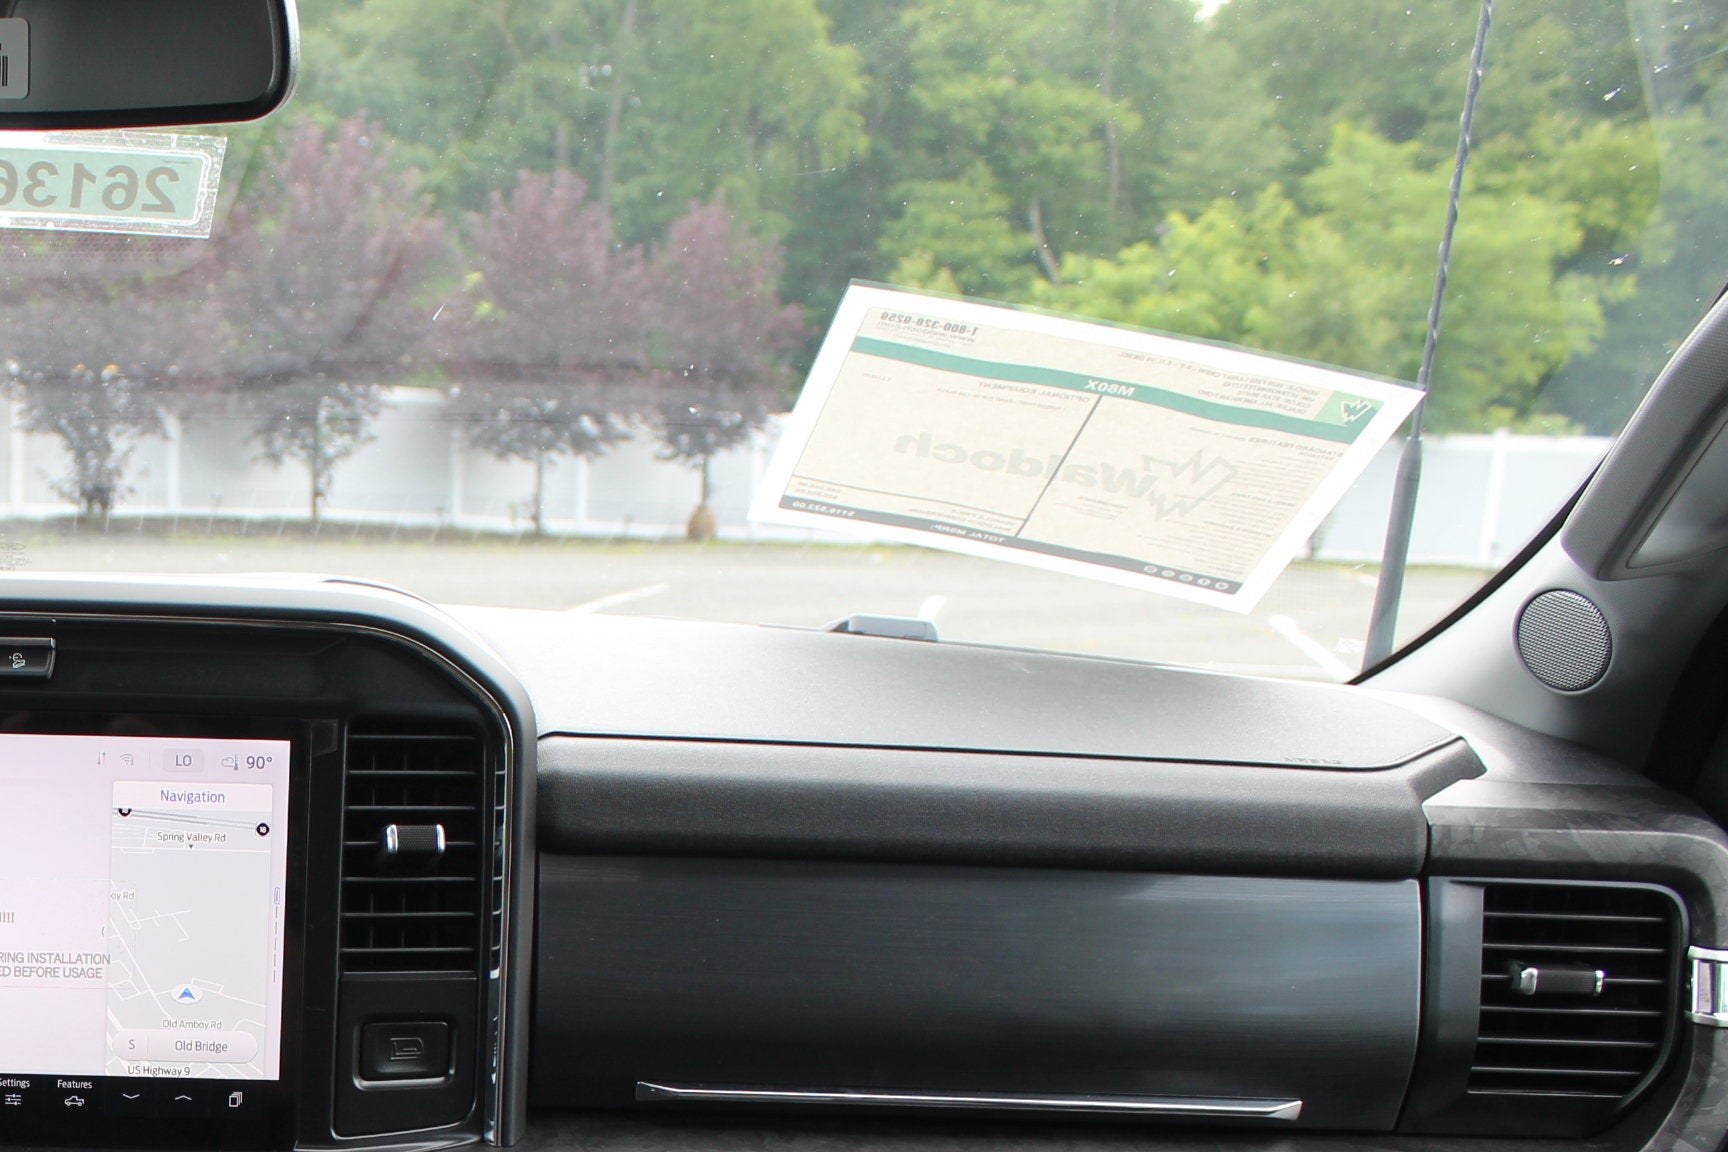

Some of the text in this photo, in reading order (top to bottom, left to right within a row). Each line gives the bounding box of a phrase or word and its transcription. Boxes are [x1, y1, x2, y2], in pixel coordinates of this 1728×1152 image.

[175, 753, 192, 767] LO
[160, 789, 225, 804] Navigation
[157, 832, 226, 843] Spring Valley Rd
[123, 891, 135, 900] Rd
[27, 952, 111, 965] INSTALLATION
[14, 966, 60, 978] BEFORE
[62, 967, 103, 979] USAGE
[162, 1019, 222, 1030] Old Amboy Rd
[128, 1039, 136, 1050] S
[175, 1041, 228, 1054] Old Bridge
[127, 1065, 191, 1077] US Highway 9
[57, 1079, 92, 1089] Features
